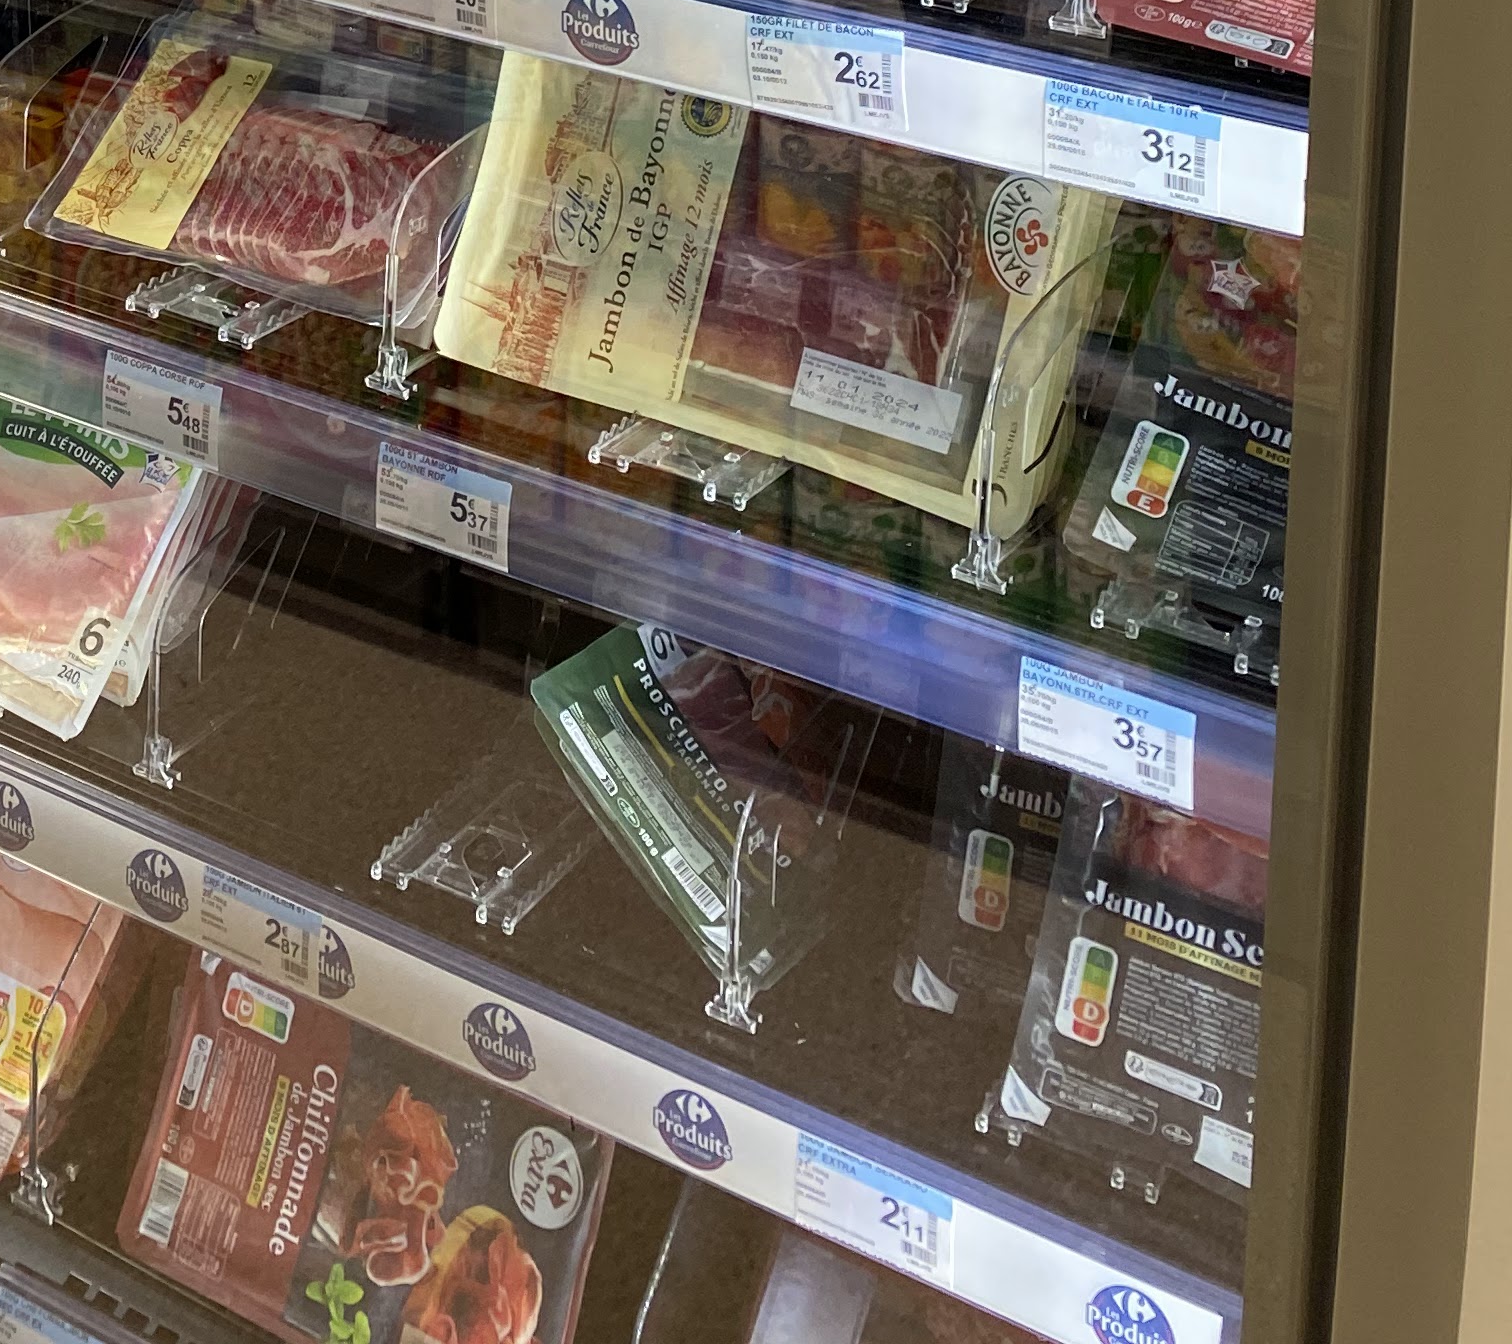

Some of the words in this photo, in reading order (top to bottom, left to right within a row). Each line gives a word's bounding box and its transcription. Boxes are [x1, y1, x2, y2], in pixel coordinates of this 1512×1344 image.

[561, 16, 641, 50] Produits
[749, 26, 771, 38] CRF
[773, 29, 794, 40] EXT
[835, 24, 874, 37] BACON
[1048, 92, 1074, 107] CRF
[1076, 99, 1099, 111] EXT
[167, 129, 194, 163] Coppa
[578, 171, 614, 253] France
[648, 203, 672, 253] IGP
[662, 234, 699, 312] Affinage
[694, 159, 713, 203] mois
[999, 183, 1033, 288] BAYONNE
[587, 261, 632, 373] Jambon
[630, 218, 644, 243] de
[159, 367, 187, 384] CORSE
[1154, 374, 1292, 448] Jambon
[5, 423, 37, 438] CUIT
[49, 431, 118, 487] L'ÉTOUFFÉE
[381, 455, 427, 479] BAYONNE
[428, 470, 446, 481] RDF
[79, 617, 110, 657] 6
[633, 658, 728, 792] PROSCIUTTO
[1126, 707, 1149, 720] EXT
[665, 731, 730, 812] STAGIONATO
[125, 866, 188, 913] Produits
[1086, 878, 1218, 950] Jambon
[269, 1064, 338, 1256] Chiffonnade
[271, 1107, 301, 1179] Jambon
